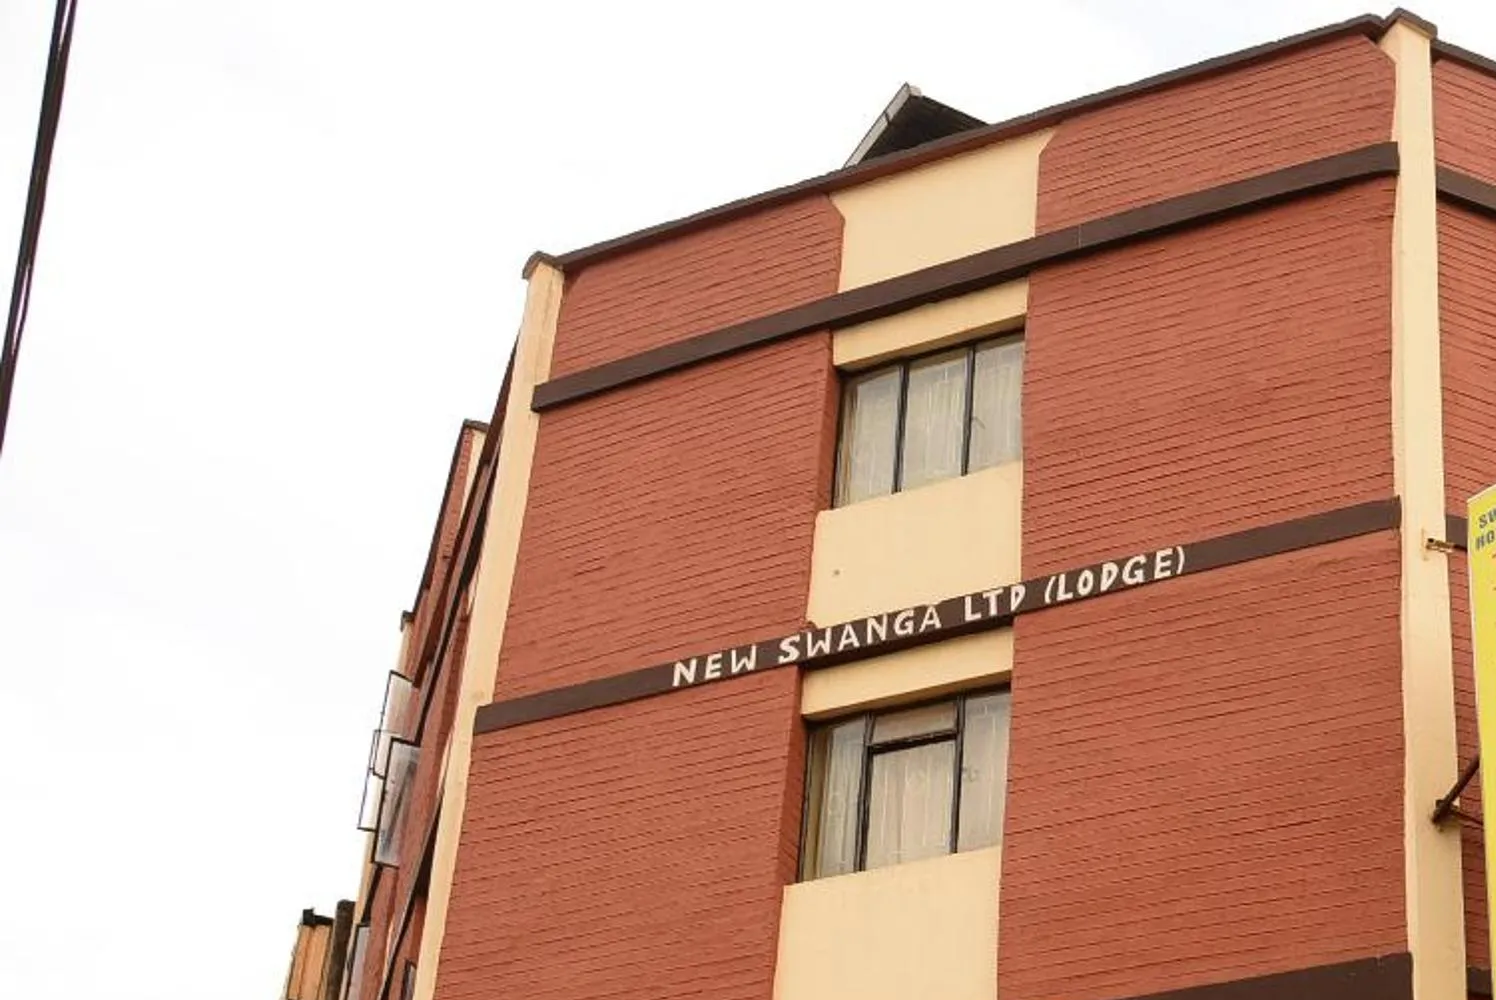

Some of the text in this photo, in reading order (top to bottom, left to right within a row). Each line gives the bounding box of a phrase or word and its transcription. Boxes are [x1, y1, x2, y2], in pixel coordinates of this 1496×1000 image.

[671, 545, 1186, 688] NEW SWANGA LTD (LODGE)
